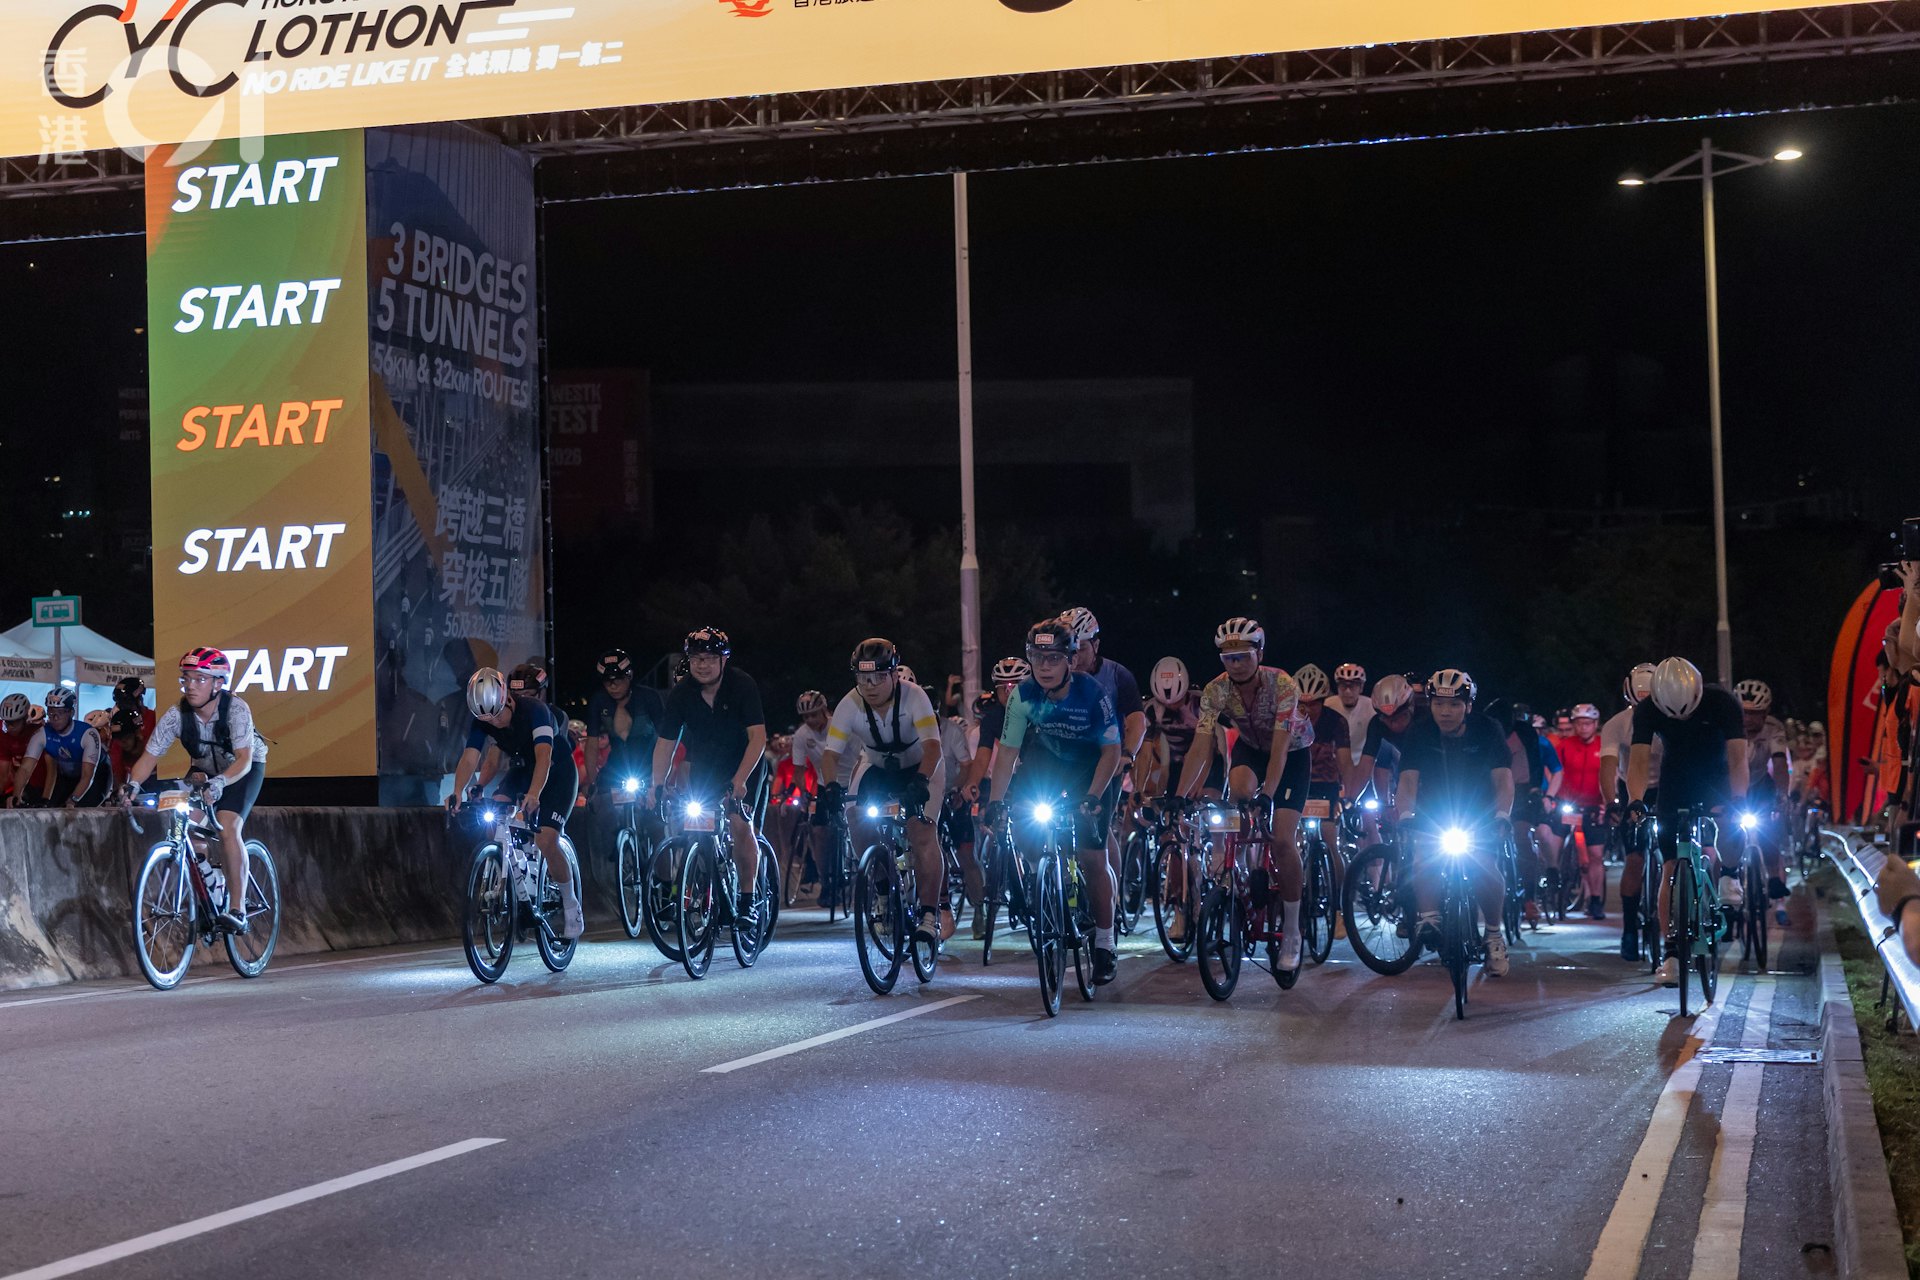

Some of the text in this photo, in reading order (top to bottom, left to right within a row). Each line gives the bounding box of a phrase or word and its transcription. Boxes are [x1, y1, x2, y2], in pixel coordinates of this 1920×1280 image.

[244, 2, 488, 62] LOTHON
[242, 57, 439, 96] NO RIDE LIKE IT
[171, 156, 339, 213] START
[387, 221, 528, 314] 3 BRIDGES
[173, 278, 342, 334] START
[376, 277, 529, 368] 5 TUNNELS
[416, 353, 430, 385] &
[433, 357, 470, 393] 32KM
[473, 367, 528, 409] ROUTES
[176, 399, 344, 452] START
[548, 404, 602, 434] FEST
[435, 484, 527, 552] 跨越三橋
[178, 523, 346, 574] START
[439, 547, 529, 611] 穿梭五隧
[222, 646, 348, 693] TART
